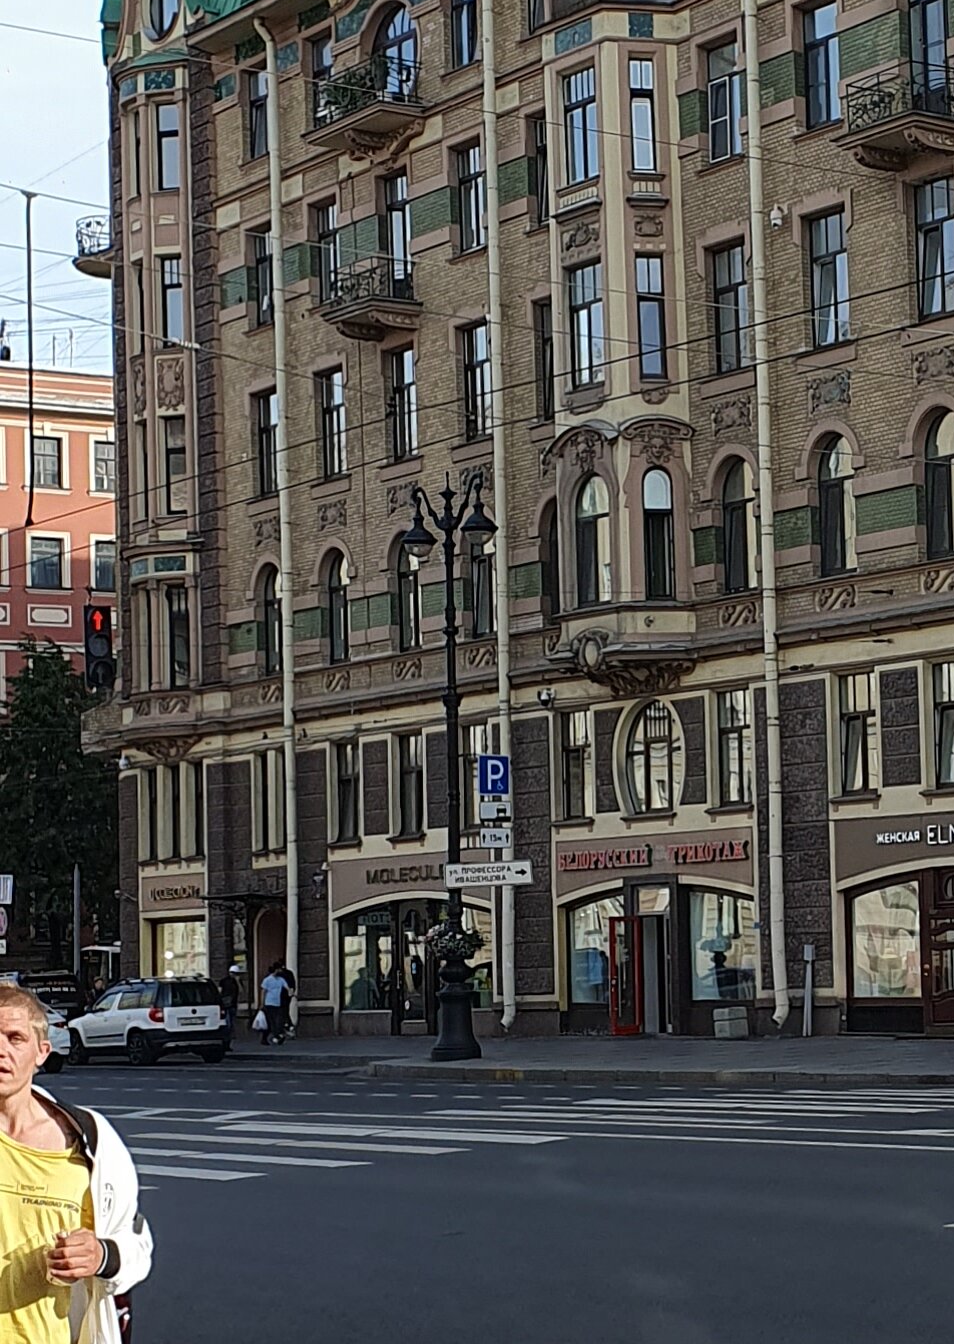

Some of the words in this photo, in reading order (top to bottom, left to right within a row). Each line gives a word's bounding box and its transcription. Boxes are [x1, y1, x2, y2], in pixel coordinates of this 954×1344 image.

[487, 760, 504, 791] P
[876, 831, 920, 844] ЖЕНСКАЯ
[557, 844, 651, 871] БЕЛОРУССКИЙ
[667, 840, 747, 865] ТРИКОТАЖ
[461, 865, 512, 874] ПРОФЕССОРА
